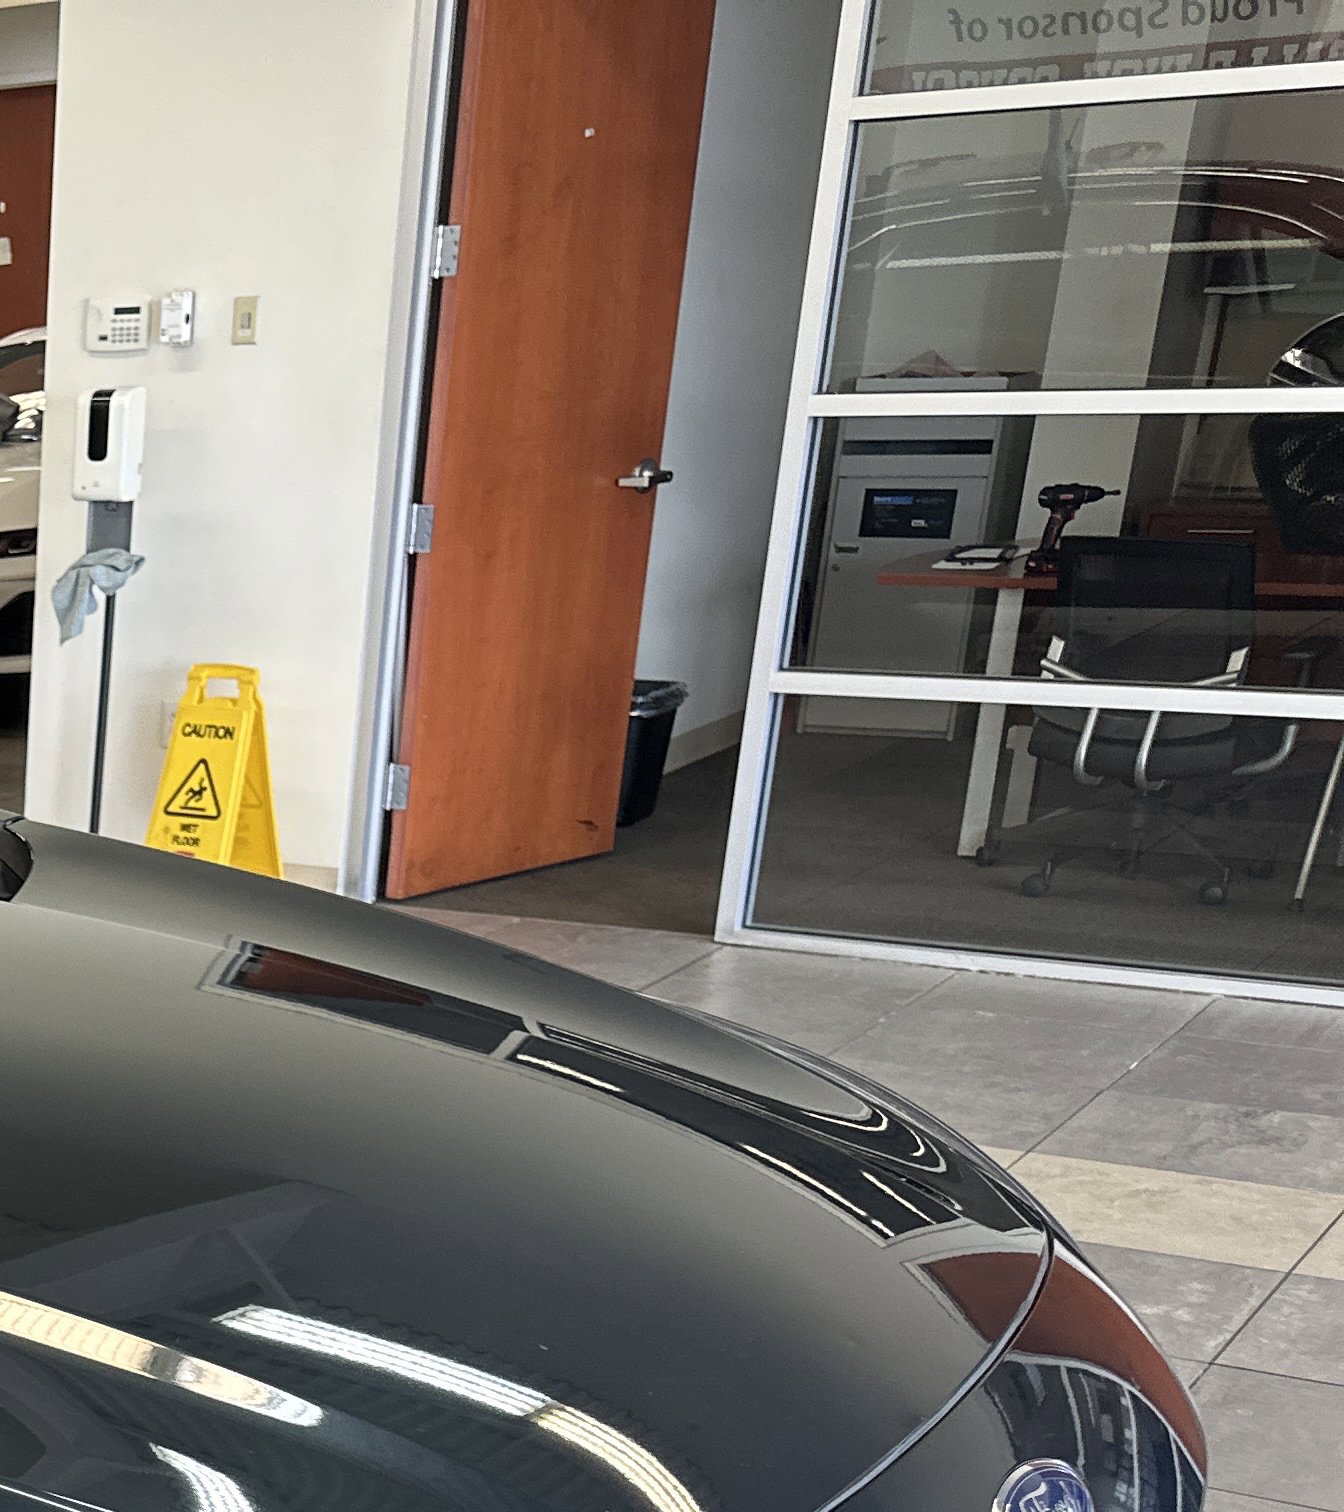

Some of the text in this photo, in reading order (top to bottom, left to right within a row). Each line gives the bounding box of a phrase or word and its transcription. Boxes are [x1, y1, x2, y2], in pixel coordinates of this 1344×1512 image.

[181, 722, 236, 740] CAUTION
[179, 822, 200, 834] WET
[172, 835, 201, 847] FLOOR
